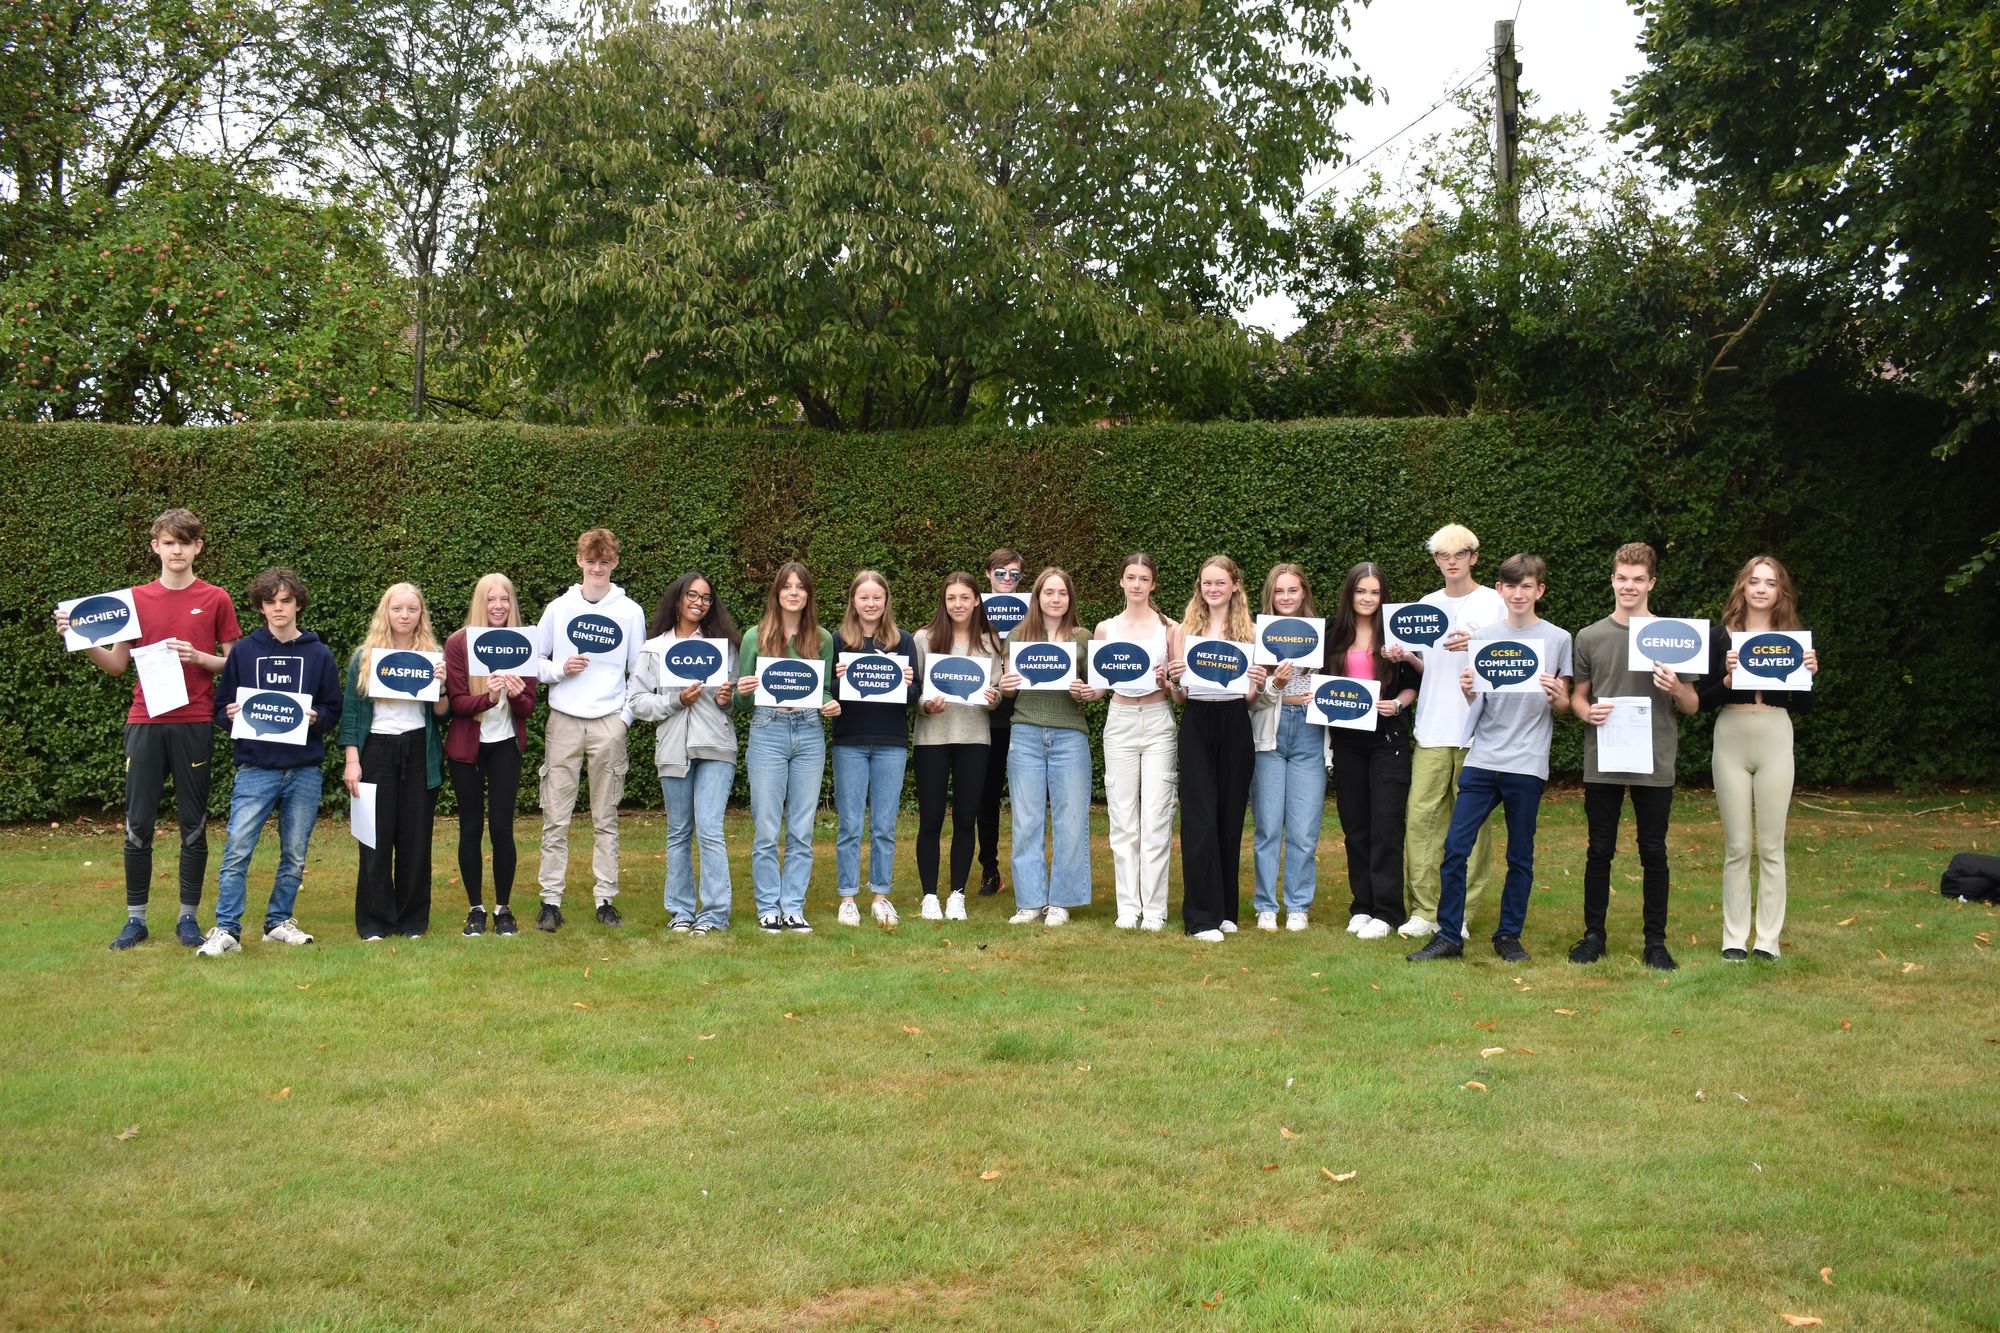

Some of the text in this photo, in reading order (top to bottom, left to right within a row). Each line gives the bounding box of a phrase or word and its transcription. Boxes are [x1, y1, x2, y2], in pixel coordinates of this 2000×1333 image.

[71, 608, 128, 627] #ACHIEVE
[1413, 614, 1439, 622] TIME
[578, 621, 615, 635] FUTURE
[1397, 625, 1441, 634] TO FLEX
[573, 631, 616, 645] EINSTEIN
[1266, 635, 1303, 643] SMASHED
[1642, 637, 1695, 649] GENIUS!
[477, 645, 529, 655] WE DID IT!
[1490, 649, 1522, 657] GCSEs?
[1752, 645, 1791, 655] GCSEs?
[671, 655, 715, 665] G.O.A.T
[1197, 651, 1239, 664] NEXT STEP:
[1748, 657, 1795, 667] SLAYED!
[856, 663, 893, 672] SMASHED
[1196, 659, 1239, 671] SIXTH FORM
[1478, 659, 1535, 667] COMPLETED
[380, 667, 430, 679] #ASPIRE
[769, 670, 812, 678] UNDERSTOOD
[933, 672, 980, 682] SUPERSTAR!
[1487, 669, 1526, 677] IT MATE.
[858, 681, 890, 689] GRADES
[253, 702, 294, 714] MADE MY
[1316, 698, 1370, 710] SMASHED IT!
[250, 712, 294, 724] MUM CRY!
